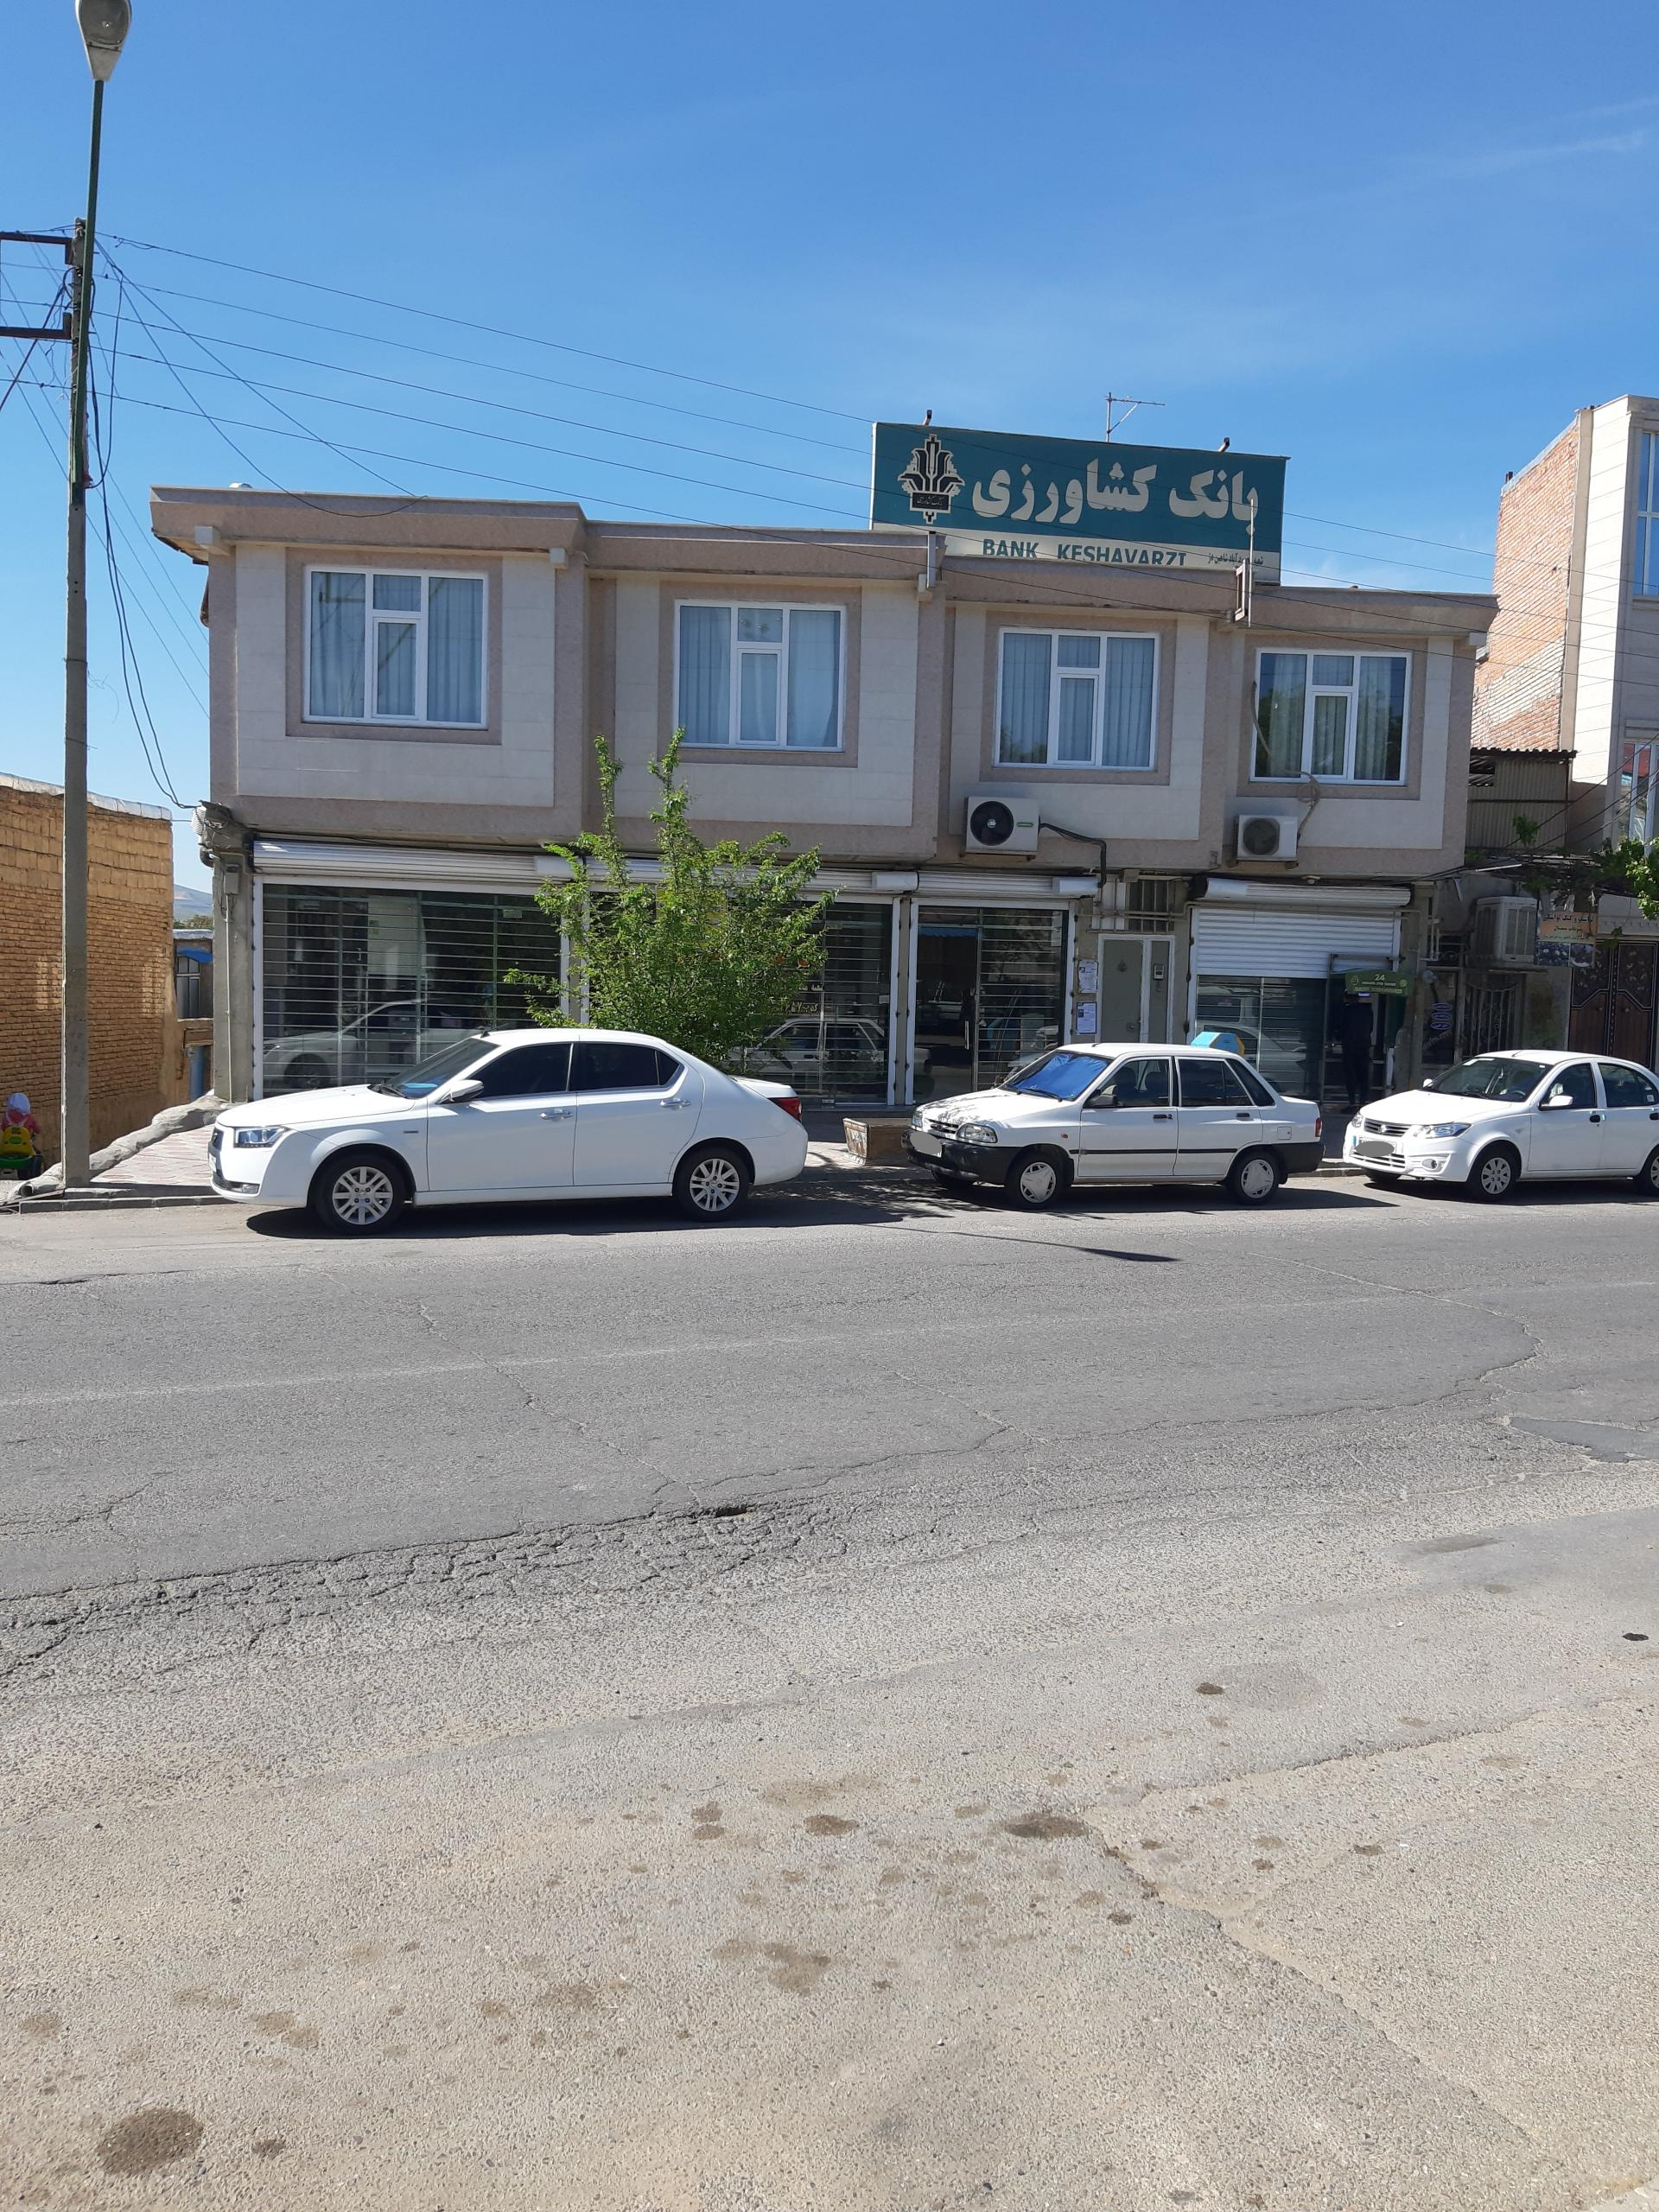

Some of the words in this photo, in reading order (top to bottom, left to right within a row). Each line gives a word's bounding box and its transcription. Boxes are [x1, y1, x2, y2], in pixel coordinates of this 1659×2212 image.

[972, 457, 1158, 524] کشاورزی
[1168, 468, 1260, 536] بانک
[982, 538, 1039, 558] BANK
